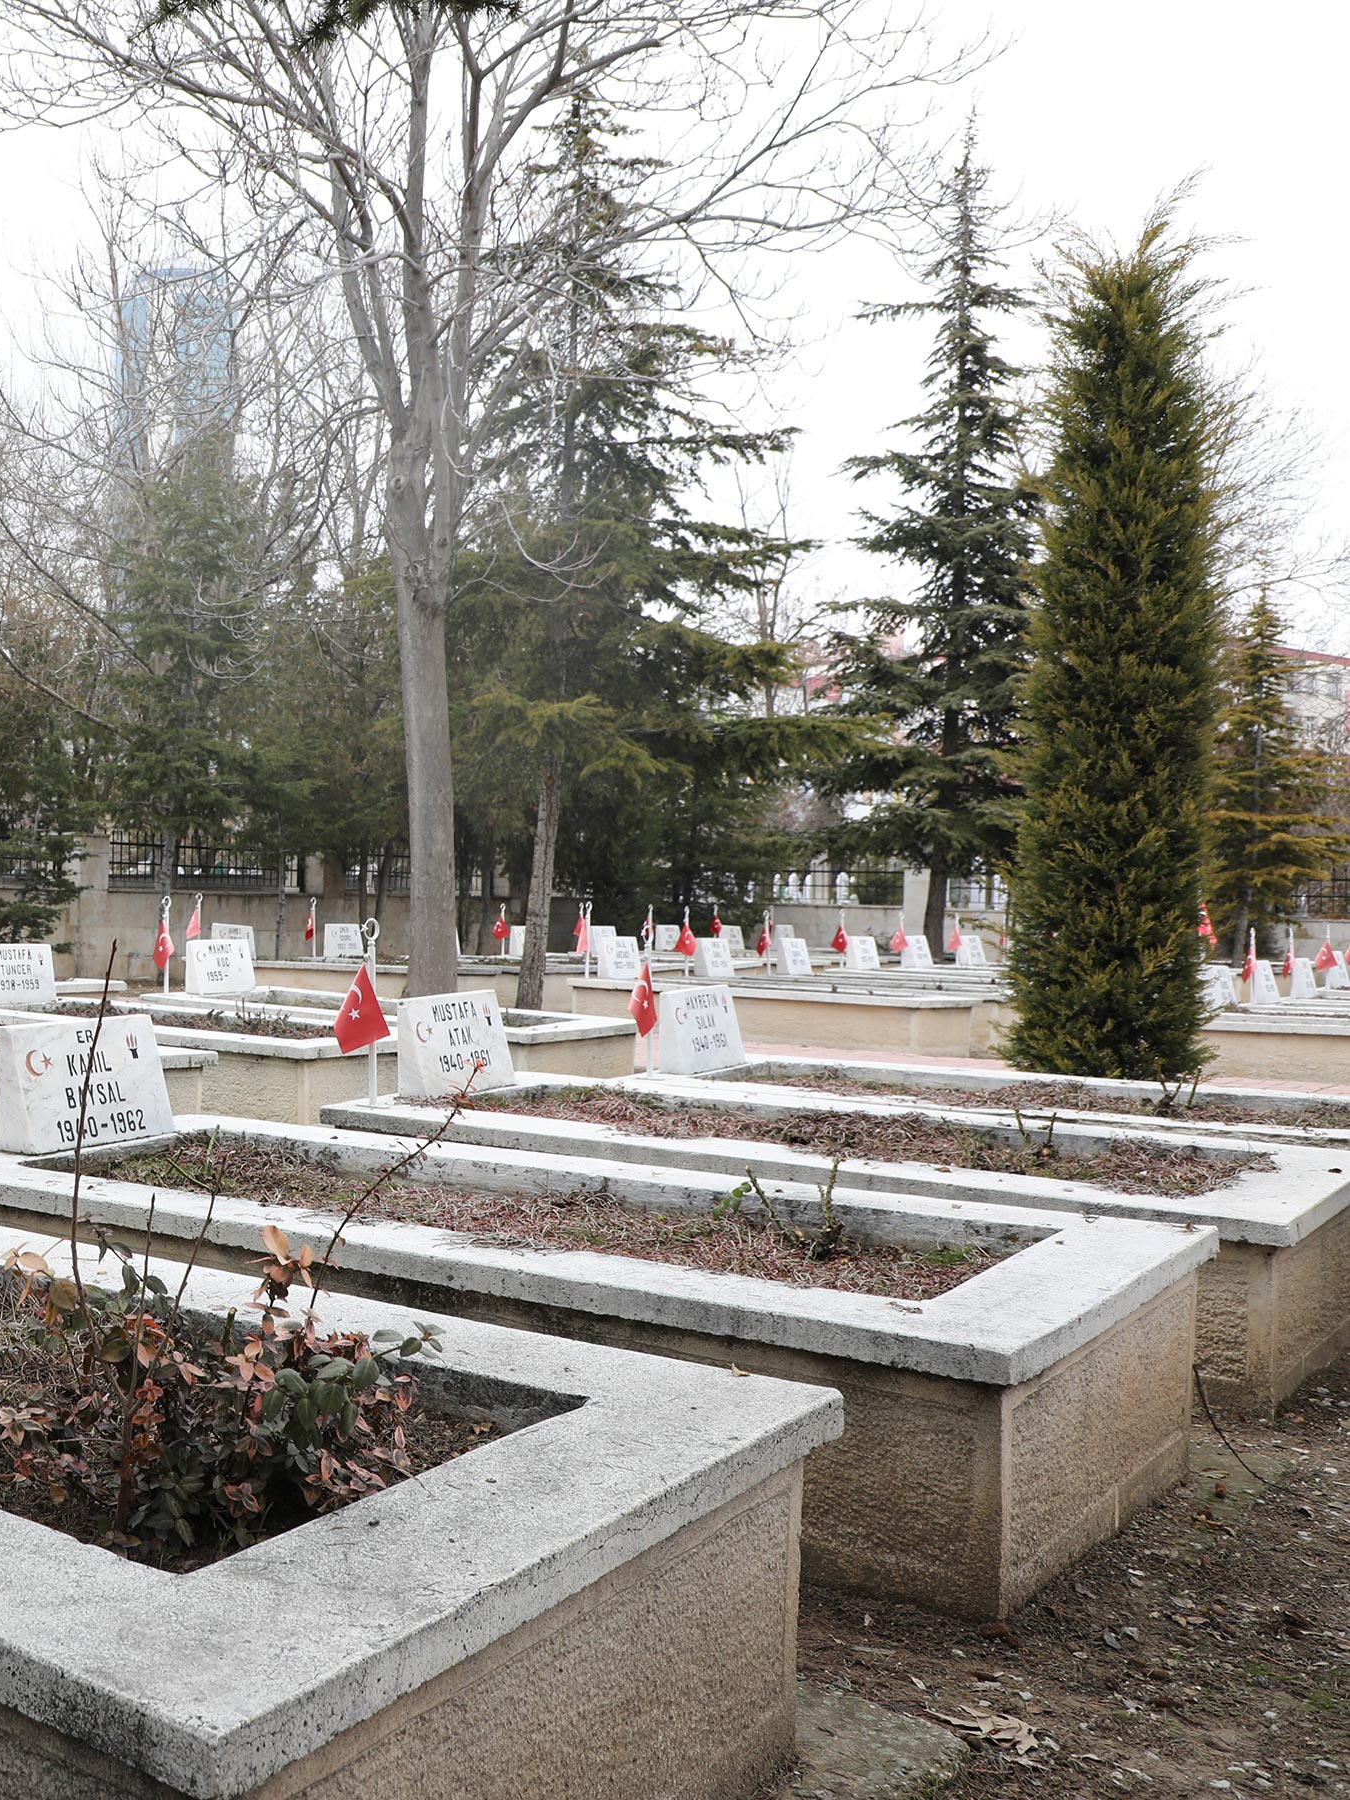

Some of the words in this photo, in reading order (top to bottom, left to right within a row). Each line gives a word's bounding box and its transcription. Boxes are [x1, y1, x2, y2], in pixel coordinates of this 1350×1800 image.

[1, 964, 33, 976] TUNCER
[431, 1000, 478, 1023] MUSTAFA
[75, 1029, 94, 1043] ER
